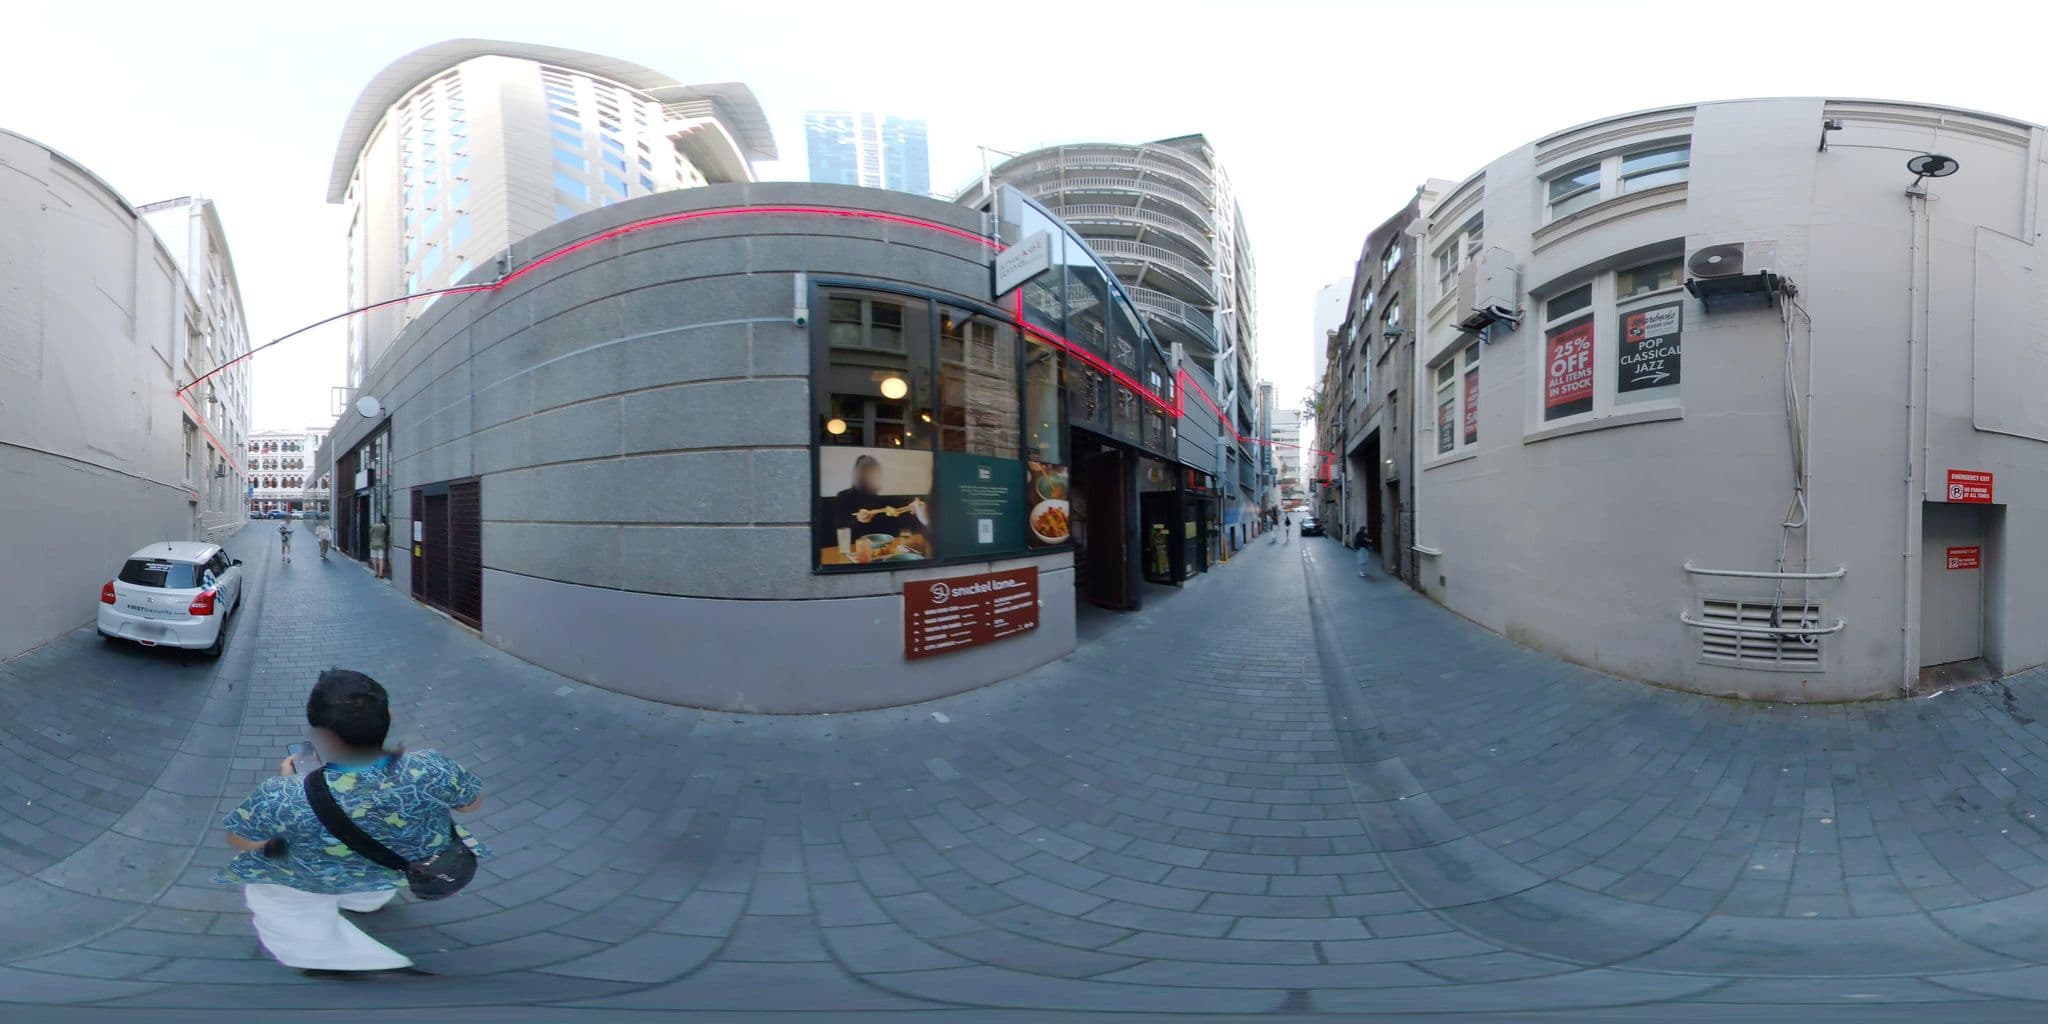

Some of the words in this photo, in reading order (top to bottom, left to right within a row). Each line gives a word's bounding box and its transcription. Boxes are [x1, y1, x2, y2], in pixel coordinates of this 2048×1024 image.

[1554, 336, 1590, 360] 25%
[1638, 338, 1663, 351] POP
[1551, 351, 1589, 378] OFF
[1620, 345, 1681, 365] CLASSICAL
[1634, 360, 1665, 374] JAZZ
[1549, 375, 1564, 388] ALL
[1566, 367, 1593, 383] ITEMS
[1549, 387, 1559, 397] IN
[1561, 378, 1592, 394] STOCK
[952, 580, 992, 597] snickel
[992, 579, 1016, 590] lane
